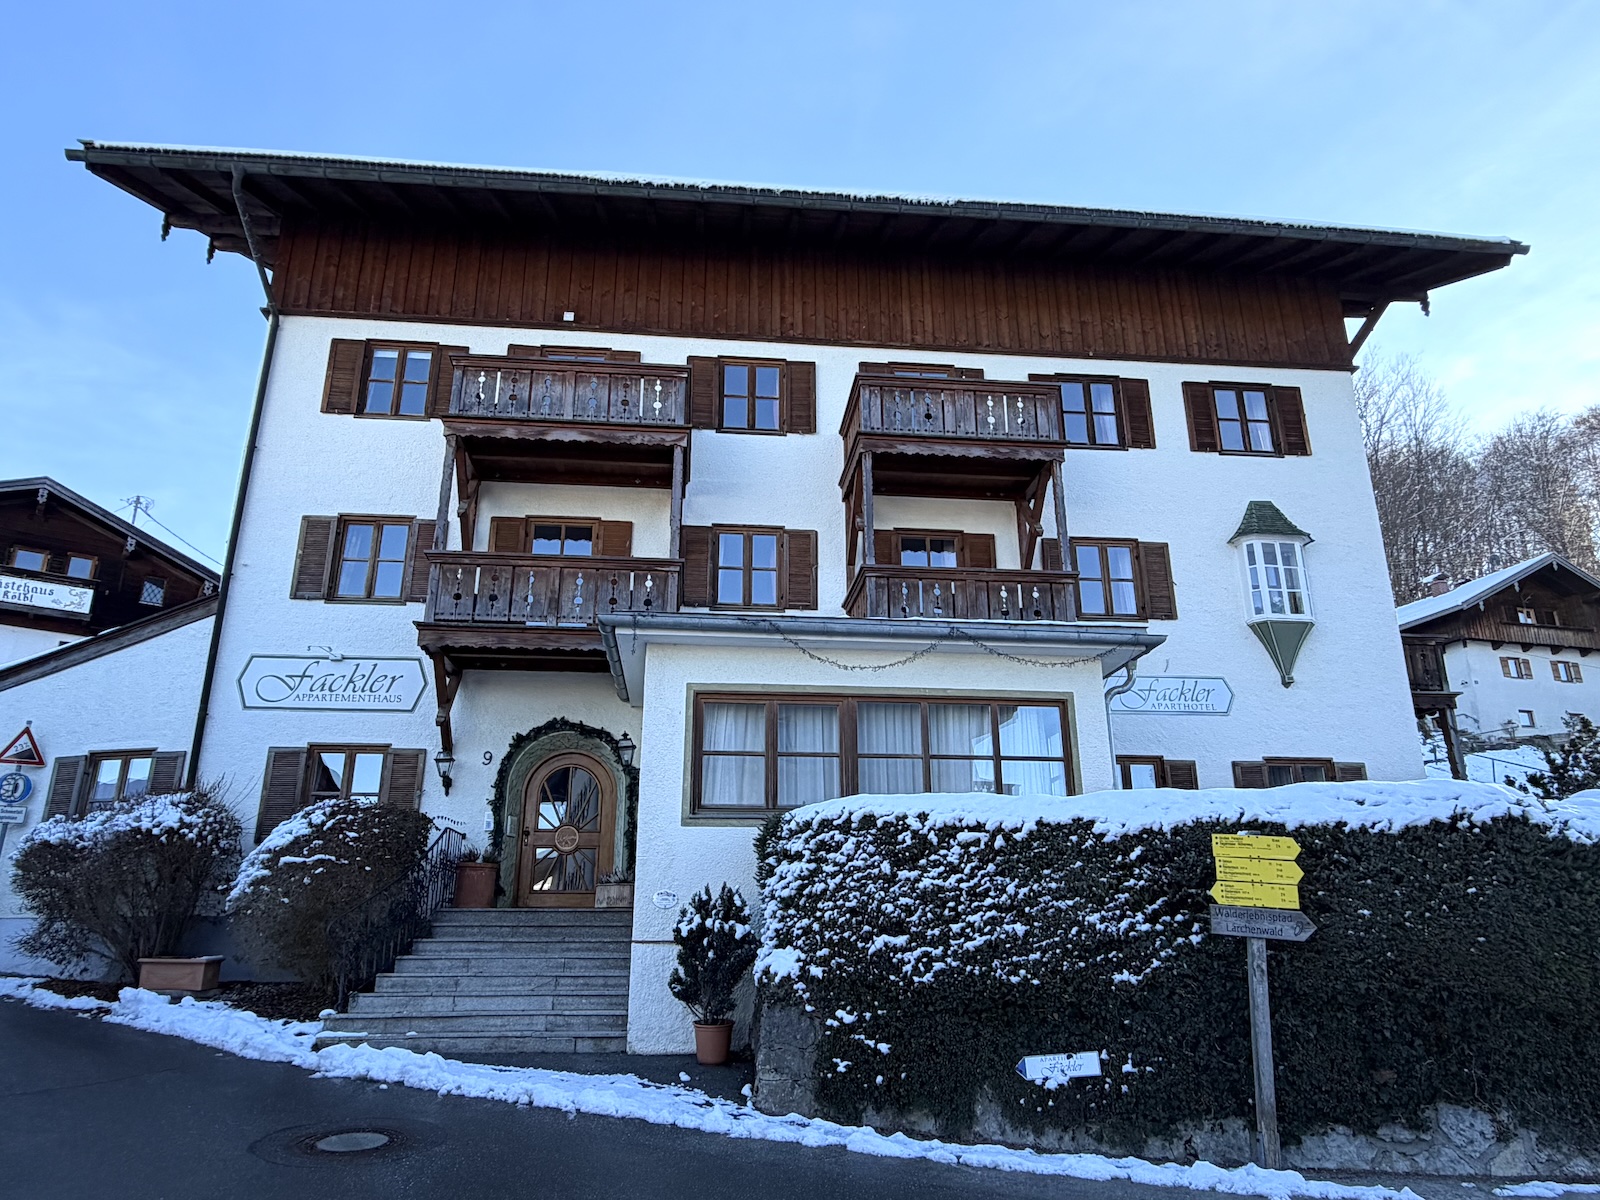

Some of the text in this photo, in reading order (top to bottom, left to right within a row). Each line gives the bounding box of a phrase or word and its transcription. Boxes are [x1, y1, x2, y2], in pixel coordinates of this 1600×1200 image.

[256, 660, 404, 702] Fackler
[292, 693, 402, 703] APPARTEMENTHAUS
[1120, 678, 1215, 709] Fackler
[1150, 703, 1218, 711] APARTHOTEL
[482, 751, 493, 765] 9
[1214, 907, 1293, 923] Walderlebnispfad
